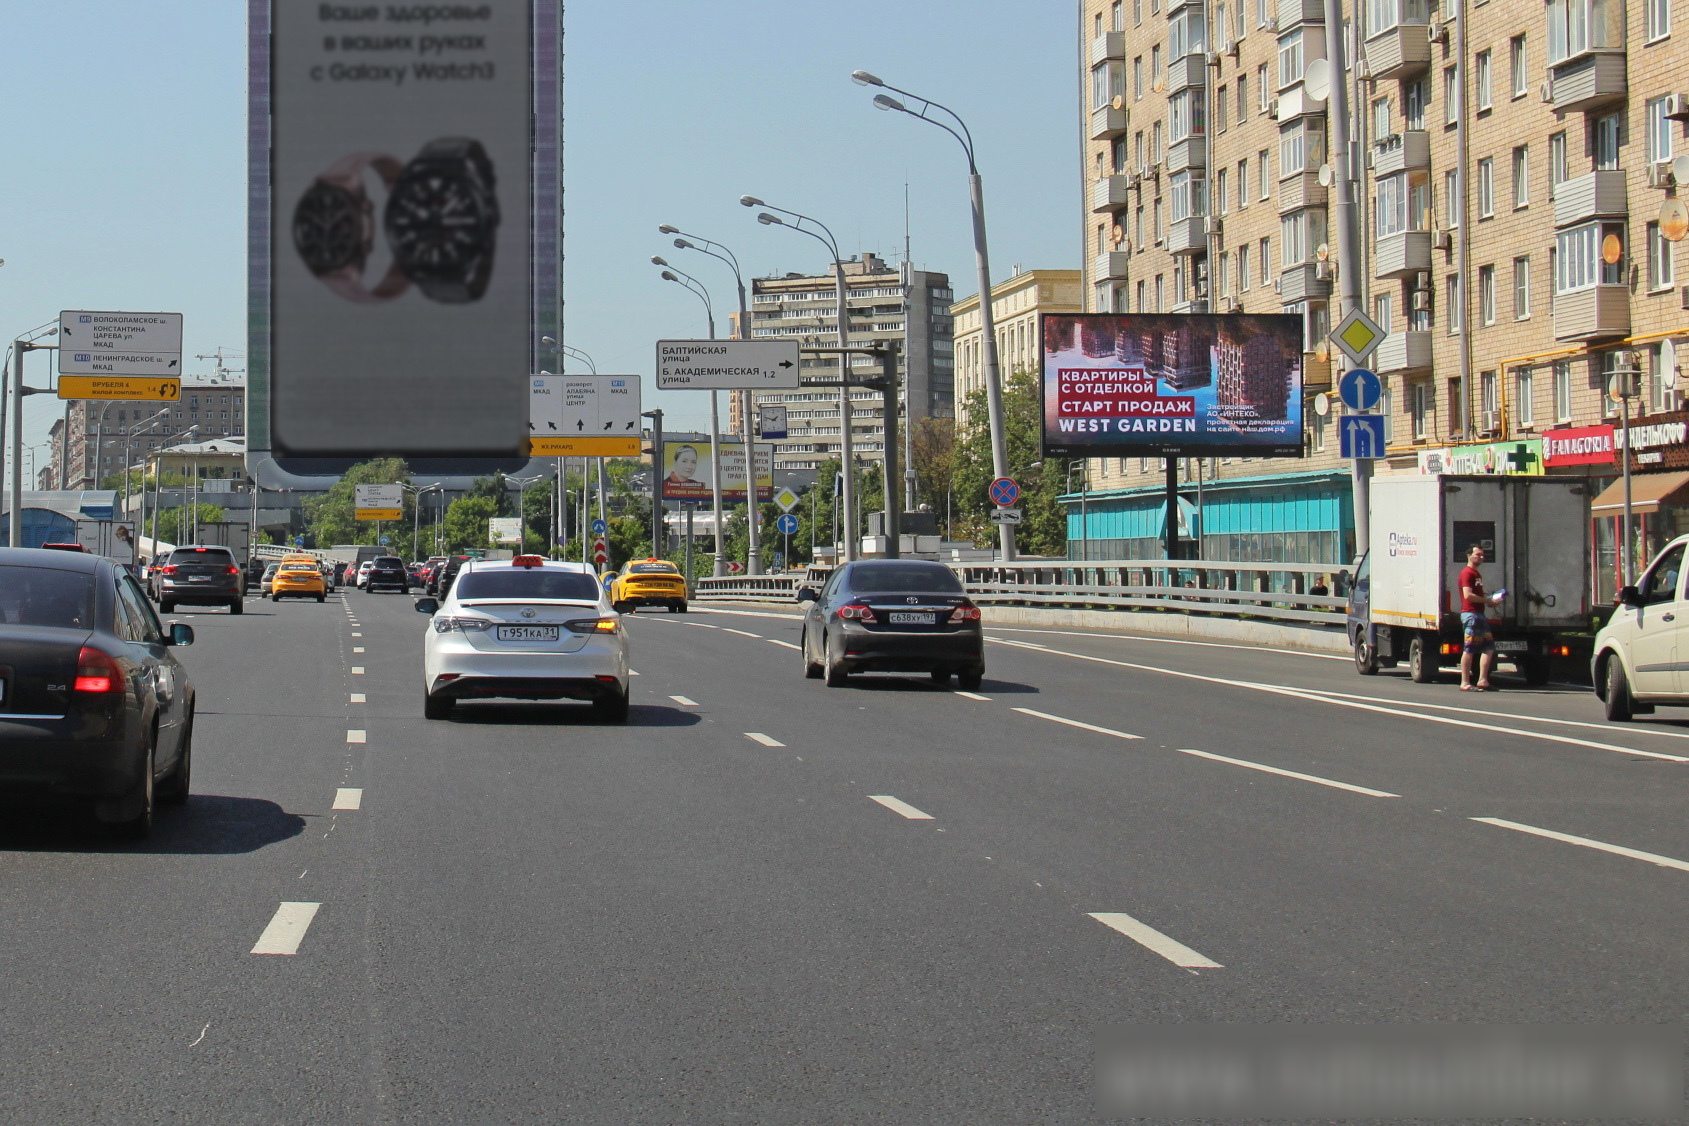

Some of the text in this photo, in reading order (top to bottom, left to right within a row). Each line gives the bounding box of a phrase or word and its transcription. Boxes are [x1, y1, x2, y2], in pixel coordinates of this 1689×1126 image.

[318, 3, 492, 26] Ваше здоровье
[323, 35, 486, 55] в ваших руках
[328, 62, 408, 86] Galaxy
[412, 62, 496, 81] Watch3
[93, 316, 158, 324] ВОЛОКОЛАМСКОЕ
[93, 325, 146, 333] КОНСТАНТИНА
[93, 332, 122, 340] ЦАРЕВА
[662, 345, 727, 355] БАЛТИЙСКАЯ
[92, 355, 155, 363] ЛЕНИНГРАДСКОЕ
[662, 355, 691, 363] улица
[662, 367, 760, 377] Б. АКАДЕМИЧЕСКАЯ
[762, 371, 776, 379] 1.2
[1061, 371, 1140, 381] КВАРТИРЫ
[662, 376, 691, 384] улица
[1061, 381, 1153, 395] С ОТДЕЛКОЙ
[1061, 401, 1192, 414] СТАРТ ПРОДАЖ
[1059, 418, 1196, 432] WEST GARDEN
[1613, 421, 1687, 451] КРНДЕЛЬКОФФ
[1551, 435, 1611, 456] FANAGORIA
[503, 627, 556, 638] Т951КА 31
